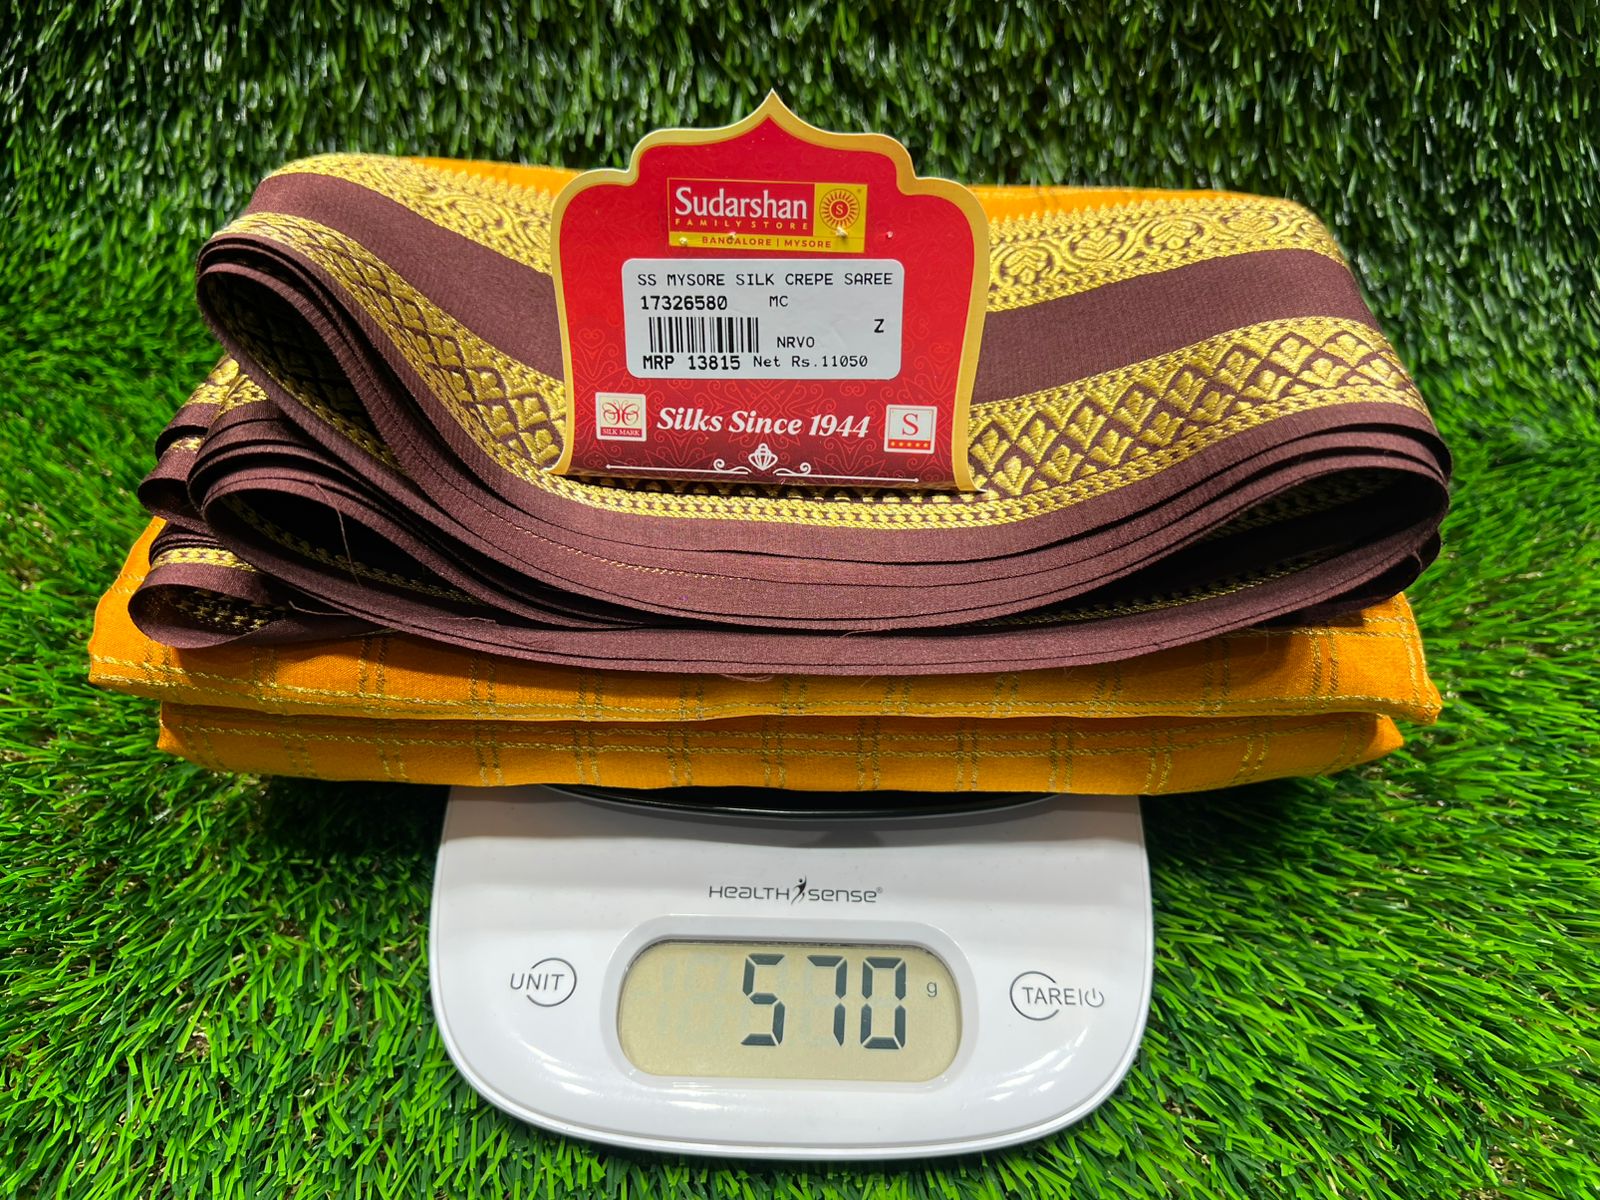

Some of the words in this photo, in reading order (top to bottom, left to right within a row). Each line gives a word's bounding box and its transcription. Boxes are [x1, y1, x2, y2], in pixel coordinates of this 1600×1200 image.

[675, 187, 808, 219] Sudarshan
[675, 218, 742, 228] FAMILY
[751, 221, 809, 230] STORE
[702, 236, 772, 246] BANGALORE
[784, 239, 832, 248] MYSORE
[638, 274, 657, 286] SS
[667, 274, 725, 286] MYSORE
[736, 273, 775, 286] SILK
[785, 273, 833, 285] CREPE
[844, 273, 893, 285] SAREE
[641, 295, 728, 310] 17326580
[769, 296, 789, 307] MC
[873, 318, 885, 333] Z
[777, 336, 815, 348] NRVO
[643, 355, 675, 370] MRP
[688, 355, 741, 370] 13815
[753, 355, 781, 368] Net
[791, 355, 868, 368] Rs.11050
[656, 407, 722, 433] Silks
[728, 410, 802, 435] Since
[808, 413, 871, 438] 1944
[902, 413, 920, 437] S
[602, 428, 618, 436] SILK
[619, 429, 640, 437] MARK
[509, 972, 565, 991] UNIT
[741, 953, 906, 1050] 570
[926, 979, 939, 998] g
